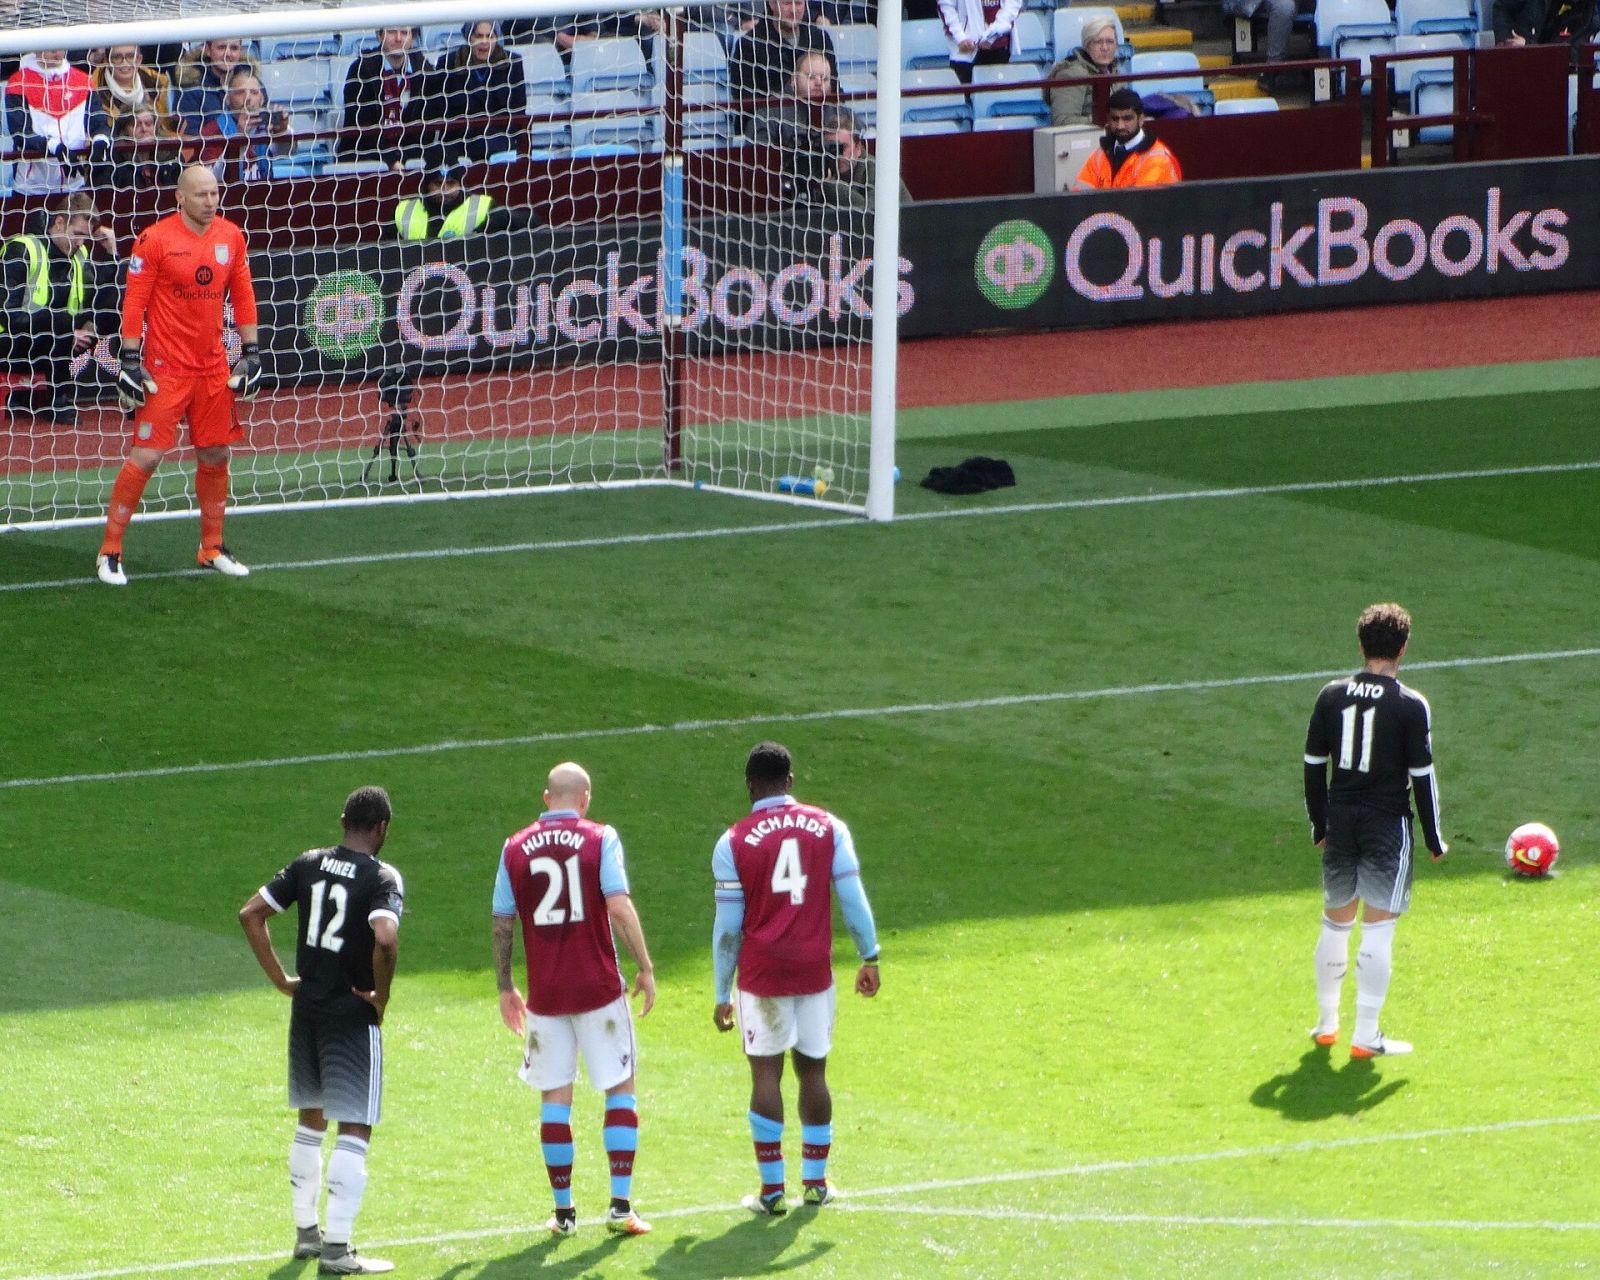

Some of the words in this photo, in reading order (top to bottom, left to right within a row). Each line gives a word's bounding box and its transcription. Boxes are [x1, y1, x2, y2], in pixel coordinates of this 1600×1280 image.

[1239, 30, 1247, 42] D
[1317, 76, 1325, 89] C
[1065, 187, 1570, 302] QuickBooks
[1346, 681, 1384, 699] PATO
[1338, 703, 1376, 774] 11
[521, 829, 585, 856] HUTTON
[744, 814, 828, 847] RICHARDS
[320, 855, 357, 879] MIKEL
[771, 838, 808, 906] 4
[529, 853, 584, 927] 21
[306, 880, 348, 953] 12
